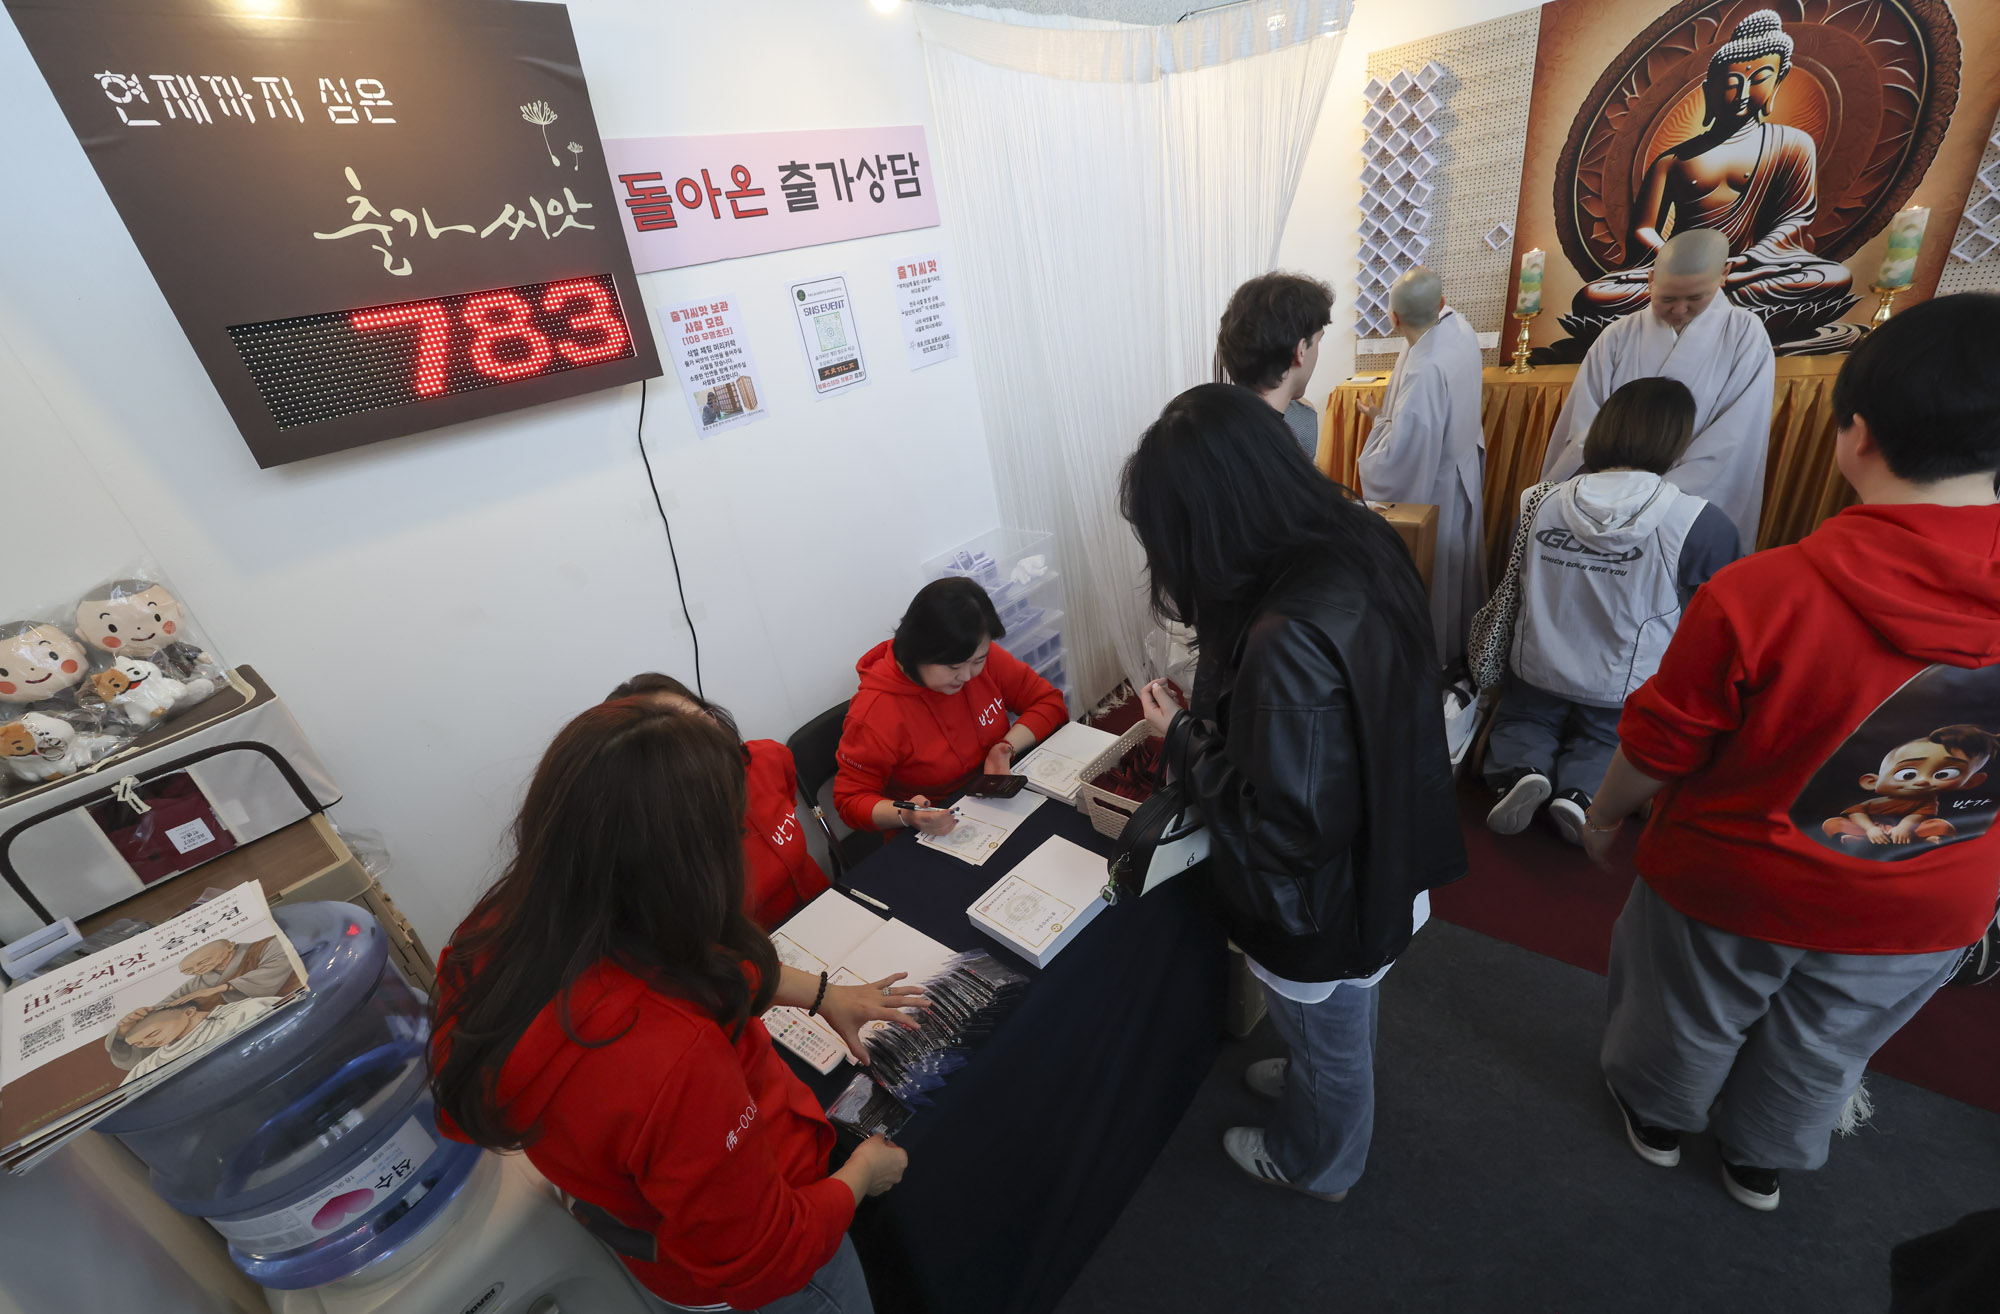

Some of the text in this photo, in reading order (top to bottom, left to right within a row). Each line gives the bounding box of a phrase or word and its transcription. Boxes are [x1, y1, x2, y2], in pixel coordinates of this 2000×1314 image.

[94, 69, 396, 127] 현재까지 심은
[618, 152, 922, 233] 돌아온 출가상담
[897, 259, 937, 280] 출가씨앗
[670, 301, 729, 322] 출가씨앗 보관
[803, 299, 845, 317] SNS EVENT
[685, 315, 724, 334] 사찰 모집
[350, 279, 634, 398] 783
[713, 339, 736, 350] 머리카락
[1540, 554, 1565, 566] WHICH
[1588, 565, 1608, 573] ARE
[1609, 568, 1628, 577] YOU
[979, 697, 1003, 726] 반가
[1952, 798, 1993, 810] 반가
[772, 812, 796, 846] 반가
[24, 951, 149, 1014] 出家씨앗
[374, 1158, 411, 1190] 석수
